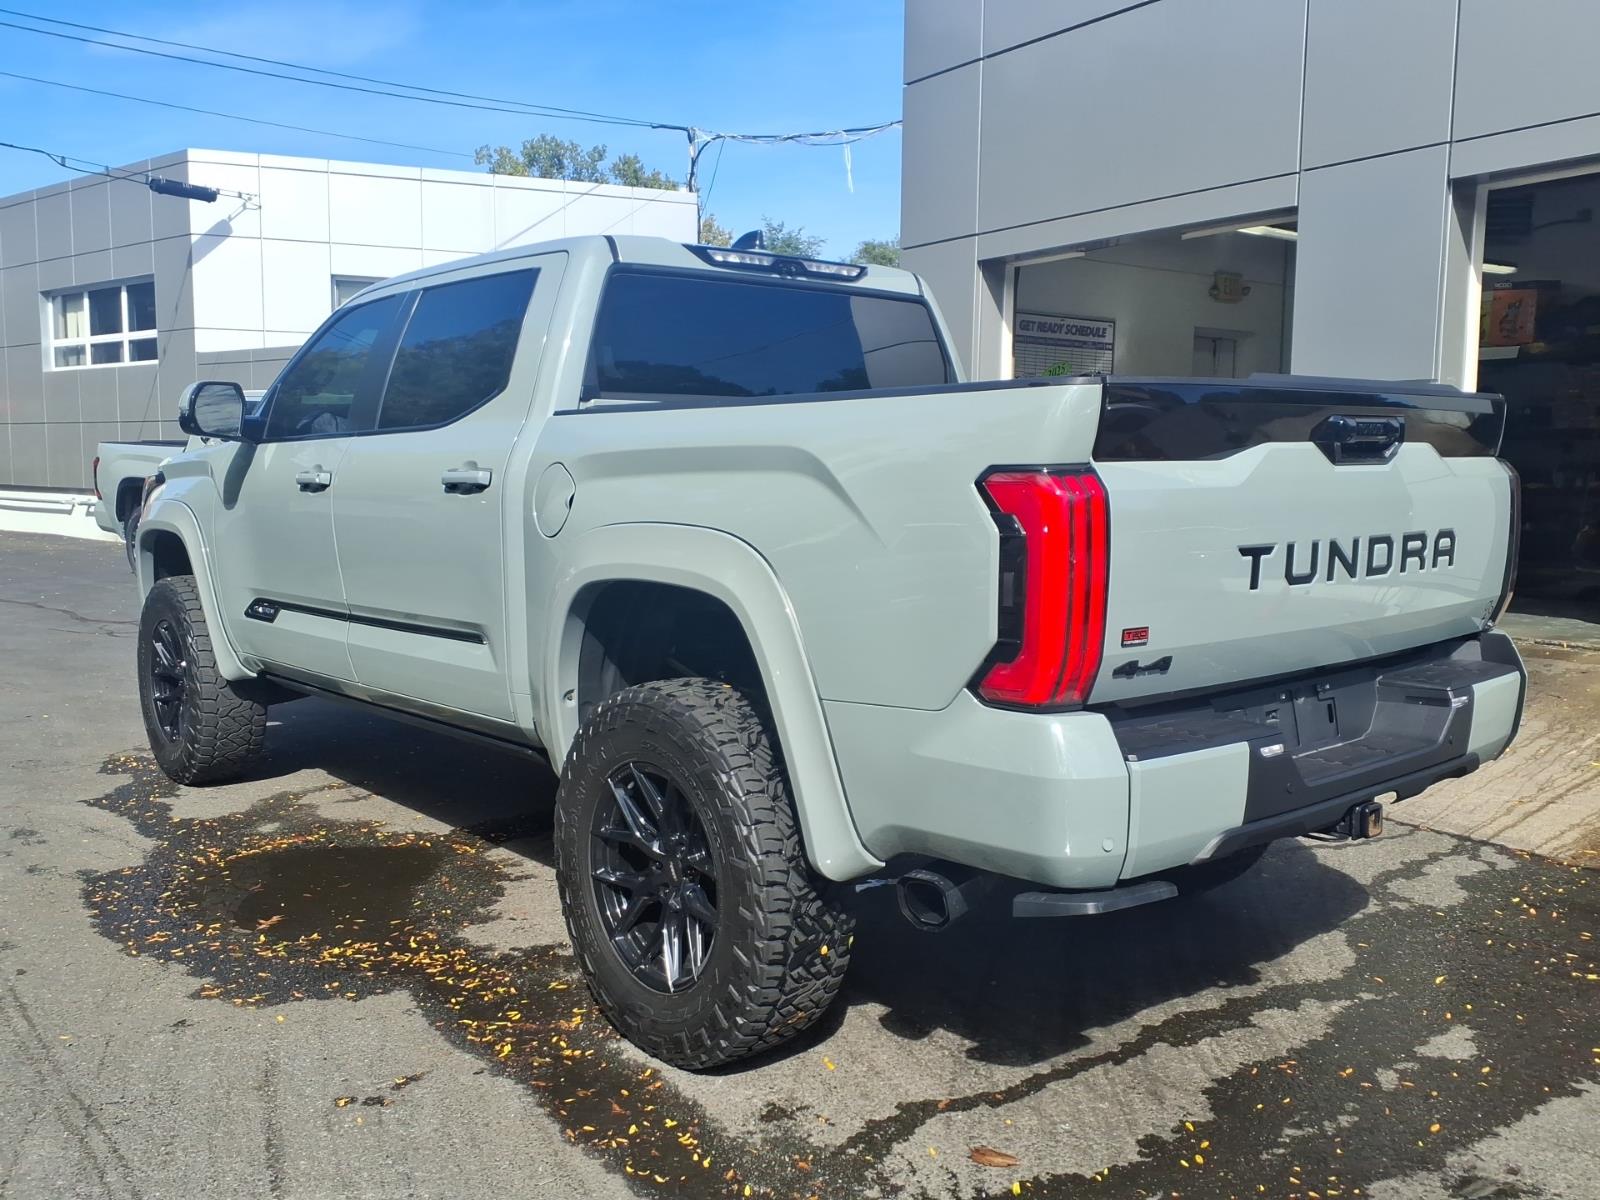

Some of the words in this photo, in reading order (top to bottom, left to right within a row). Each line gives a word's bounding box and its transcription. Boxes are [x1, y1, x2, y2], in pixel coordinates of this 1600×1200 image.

[1019, 319, 1036, 332] GET
[1036, 321, 1065, 334] READY
[1065, 323, 1107, 338] SCHEDULE
[1238, 528, 1456, 590] TUNDRA
